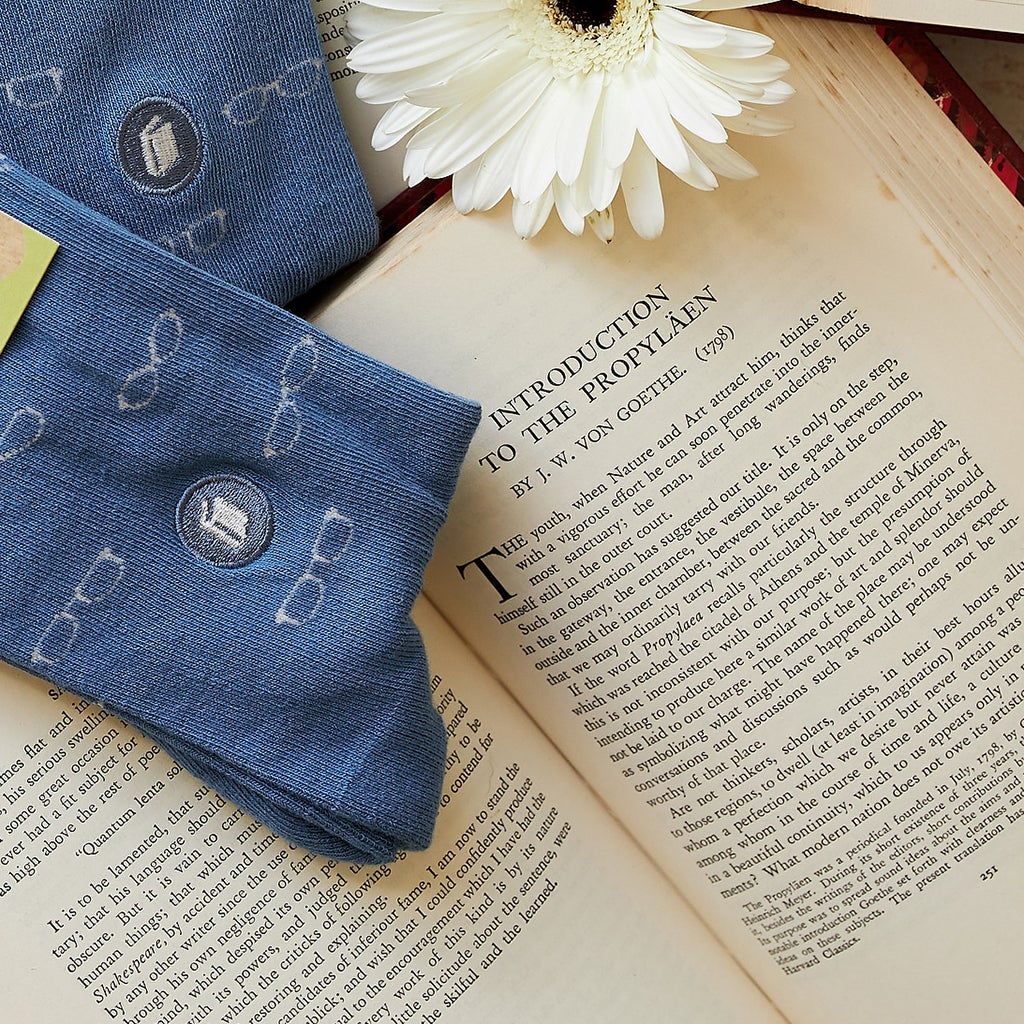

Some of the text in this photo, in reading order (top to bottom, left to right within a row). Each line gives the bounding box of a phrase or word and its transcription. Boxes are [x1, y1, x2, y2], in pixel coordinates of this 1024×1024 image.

[478, 284, 717, 473] TO THE PROPYLÄEN
[487, 283, 670, 431] INTRODUCTION
[509, 325, 734, 499] BY J. W. VON GOETHE. (1798)
[529, 510, 571, 542] youth,
[571, 483, 608, 510] when
[606, 448, 655, 485] Nature
[657, 423, 682, 449] and
[685, 406, 708, 429] Art
[709, 372, 749, 407] attract
[746, 351, 780, 374] him,
[779, 314, 819, 348] thinks
[819, 291, 847, 315] that
[515, 309, 858, 570] with a vigorous effort he can soon penetrate into the inner-
[0, 840, 25, 865] ever
[23, 815, 51, 842] had
[51, 809, 62, 819] a
[59, 793, 78, 810] fit
[78, 755, 119, 795] subject
[116, 736, 138, 757] for
[856, 767, 1014, 882] of the editors, short contributions
[979, 865, 998, 881] 251
